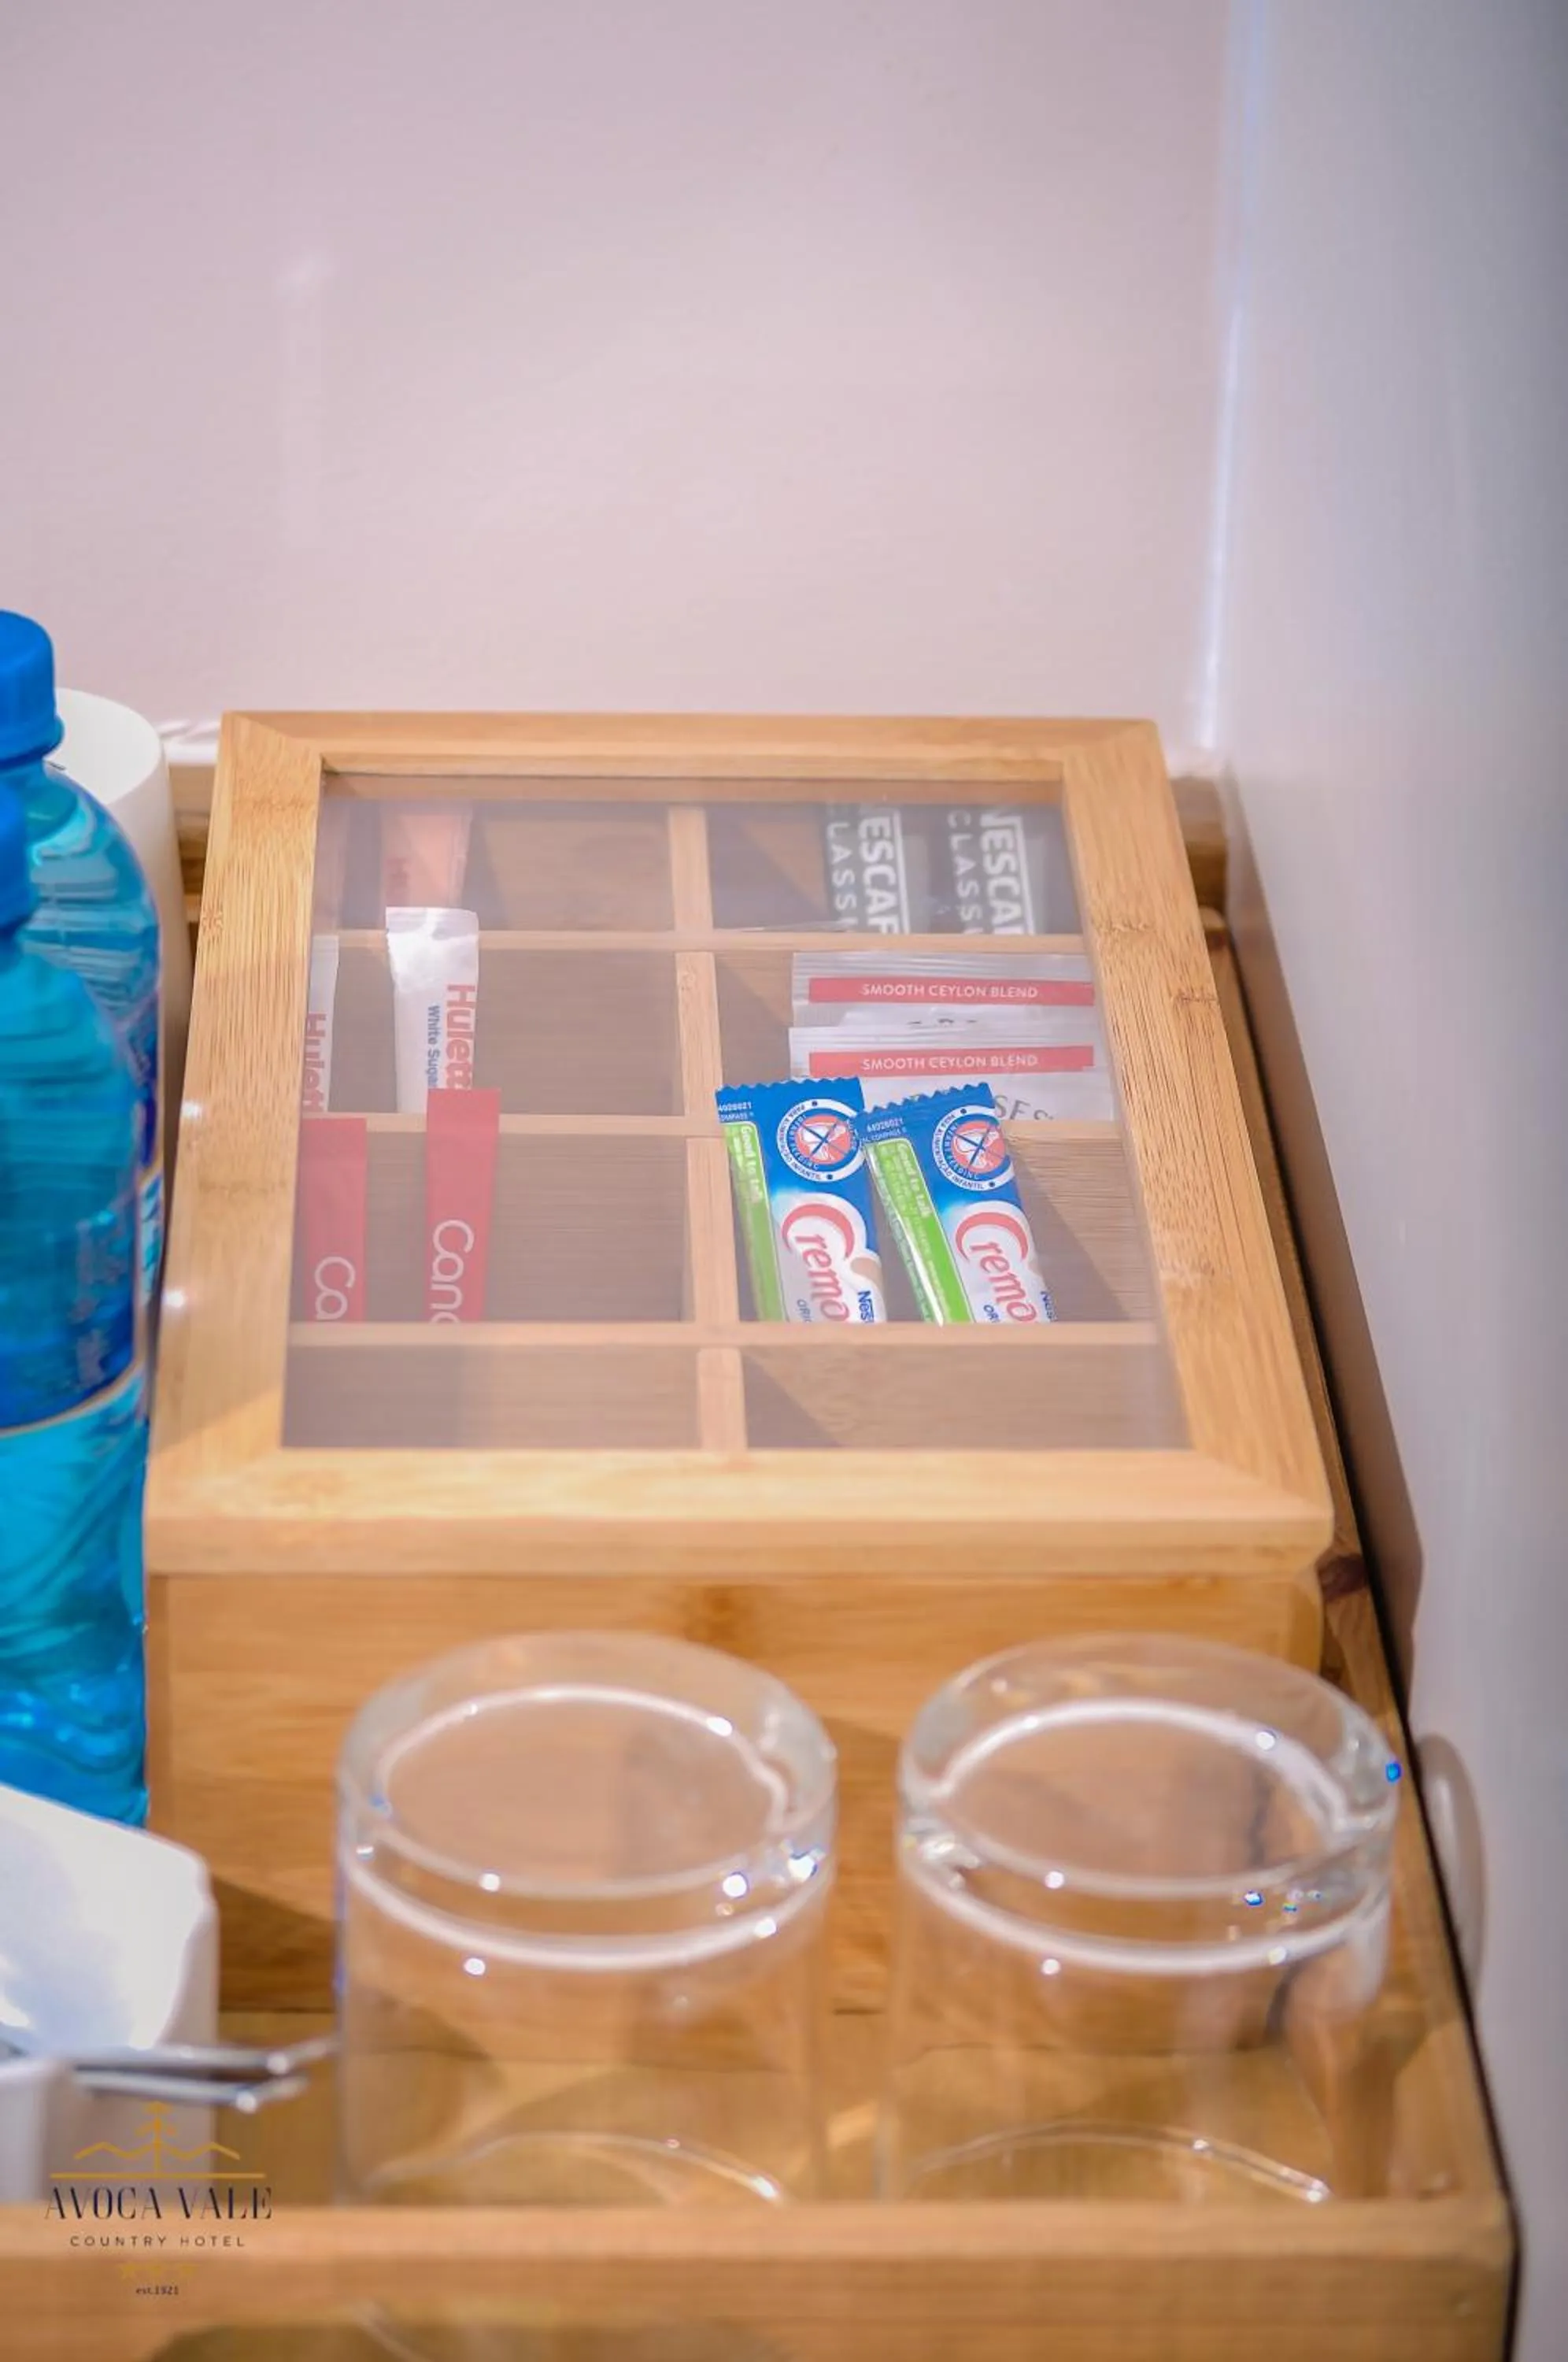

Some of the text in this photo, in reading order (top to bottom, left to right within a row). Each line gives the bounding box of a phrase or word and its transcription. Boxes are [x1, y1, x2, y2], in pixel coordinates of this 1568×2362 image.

[827, 821, 858, 926] LASSI
[858, 816, 900, 934] ESCAF
[862, 983, 1038, 998] SMOOTH CEYLON BLEND
[427, 1006, 440, 1046] White
[862, 1055, 1038, 1070] SMOOTH CEYLON BLEND
